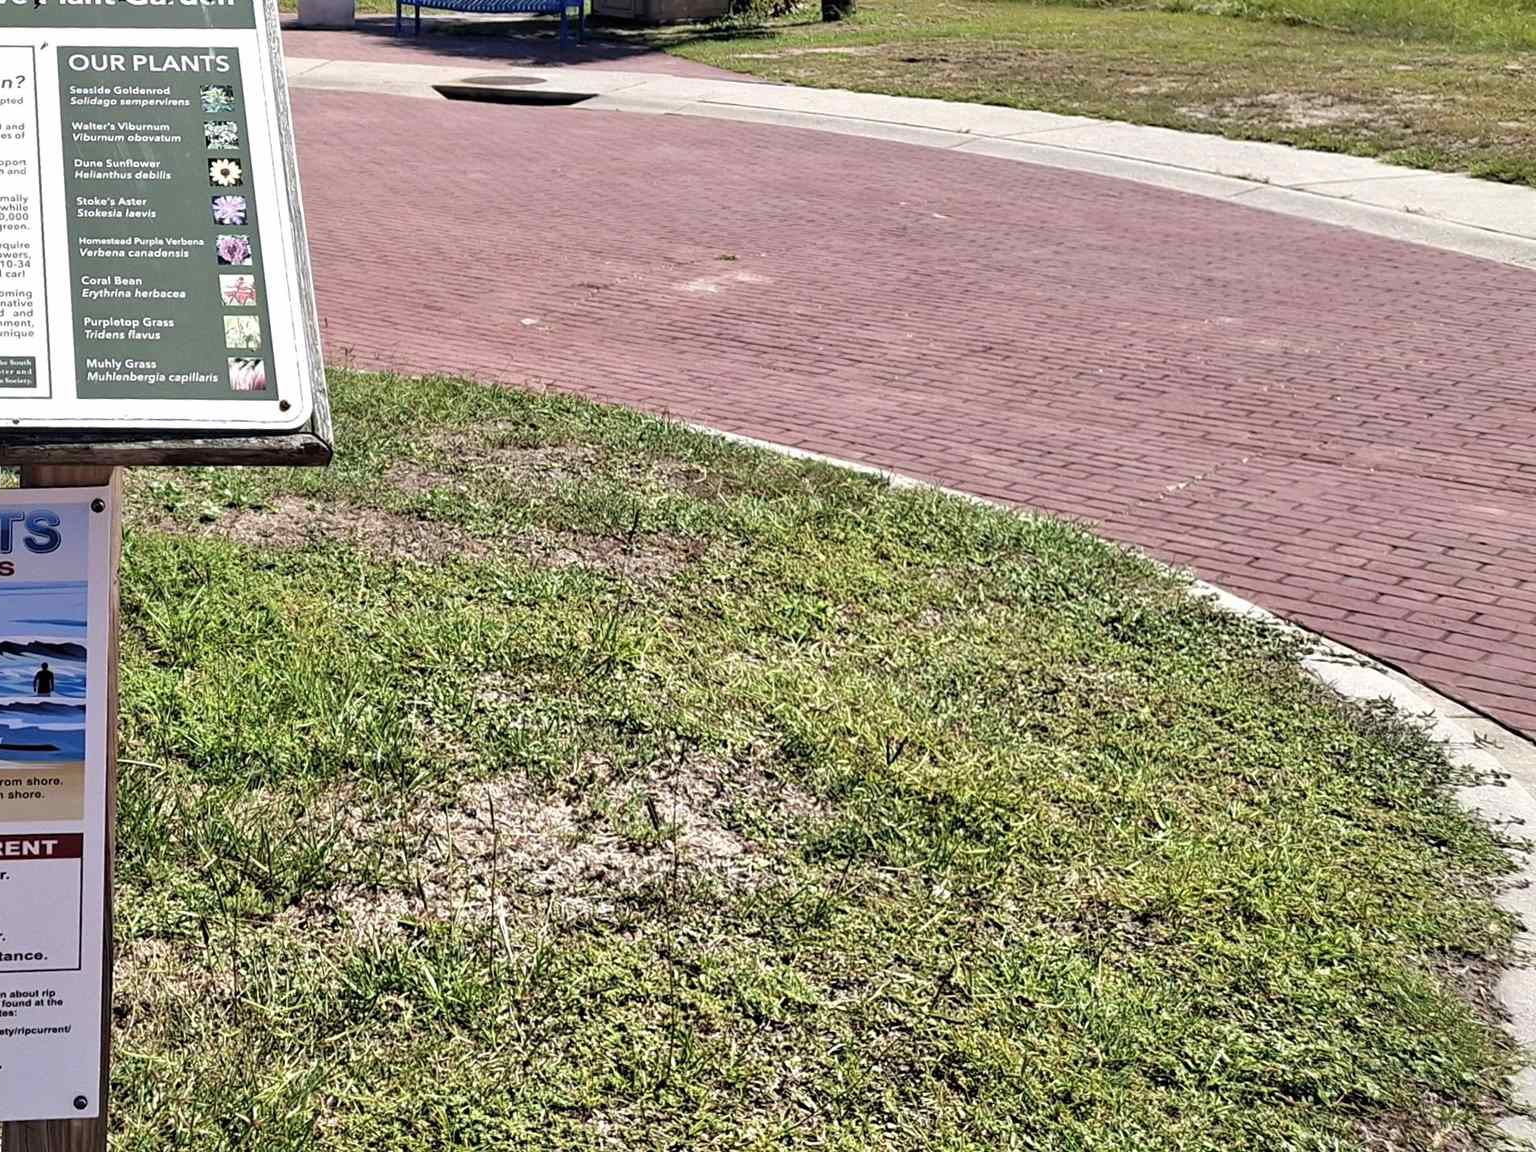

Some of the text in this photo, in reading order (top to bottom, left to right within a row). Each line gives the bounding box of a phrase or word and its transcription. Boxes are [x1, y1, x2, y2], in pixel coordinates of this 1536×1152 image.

[69, 54, 230, 72] OUR PLANTS
[70, 86, 170, 95] Seaside Goldenrod
[70, 97, 190, 107] Solidago sempervirens
[72, 122, 170, 131] Walter's Viburnum
[72, 133, 181, 143] Viburnum obovatum
[74, 159, 160, 168] Dune Sunflower
[74, 171, 171, 180] Helianthus debilis
[76, 197, 147, 206] Stoke's Aster
[77, 209, 156, 218] Stokesia laevis
[79, 237, 205, 248] Homestead Purple Verbena
[79, 248, 189, 258] Verbena canadensis
[82, 276, 142, 285] Coral Bean
[82, 289, 186, 300] Erythrina herbacea
[84, 317, 174, 329] Purpletop Grass
[85, 330, 160, 340] Tridens flavus
[86, 359, 157, 370] Muhly Grass
[87, 372, 218, 384] Muhlenbergia capillaris
[26, 777, 63, 786] shore.
[9, 990, 38, 998] about
[42, 989, 56, 998] rip
